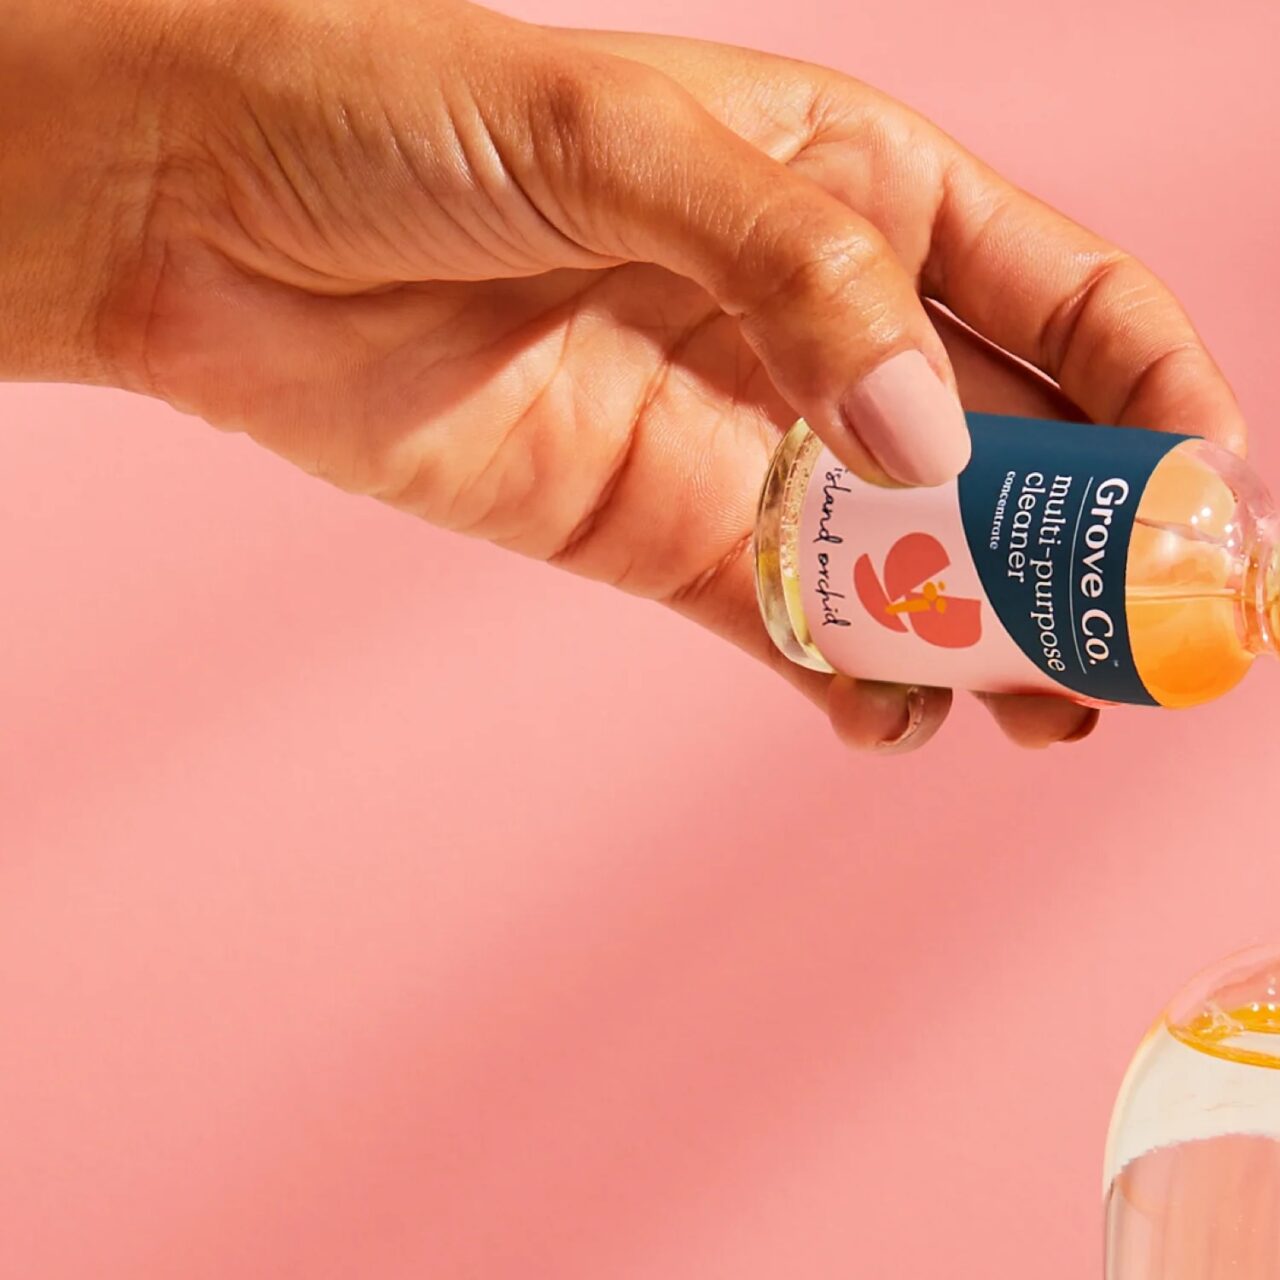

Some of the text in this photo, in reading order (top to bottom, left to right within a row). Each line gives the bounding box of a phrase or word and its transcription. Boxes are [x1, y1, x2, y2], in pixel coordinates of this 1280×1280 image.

[813, 467, 851, 626] island orchid
[990, 470, 1016, 550] concentrate
[1008, 471, 1045, 583] cleaner
[1029, 475, 1072, 671] multi-purpose
[1080, 477, 1129, 665] Grove Co.
